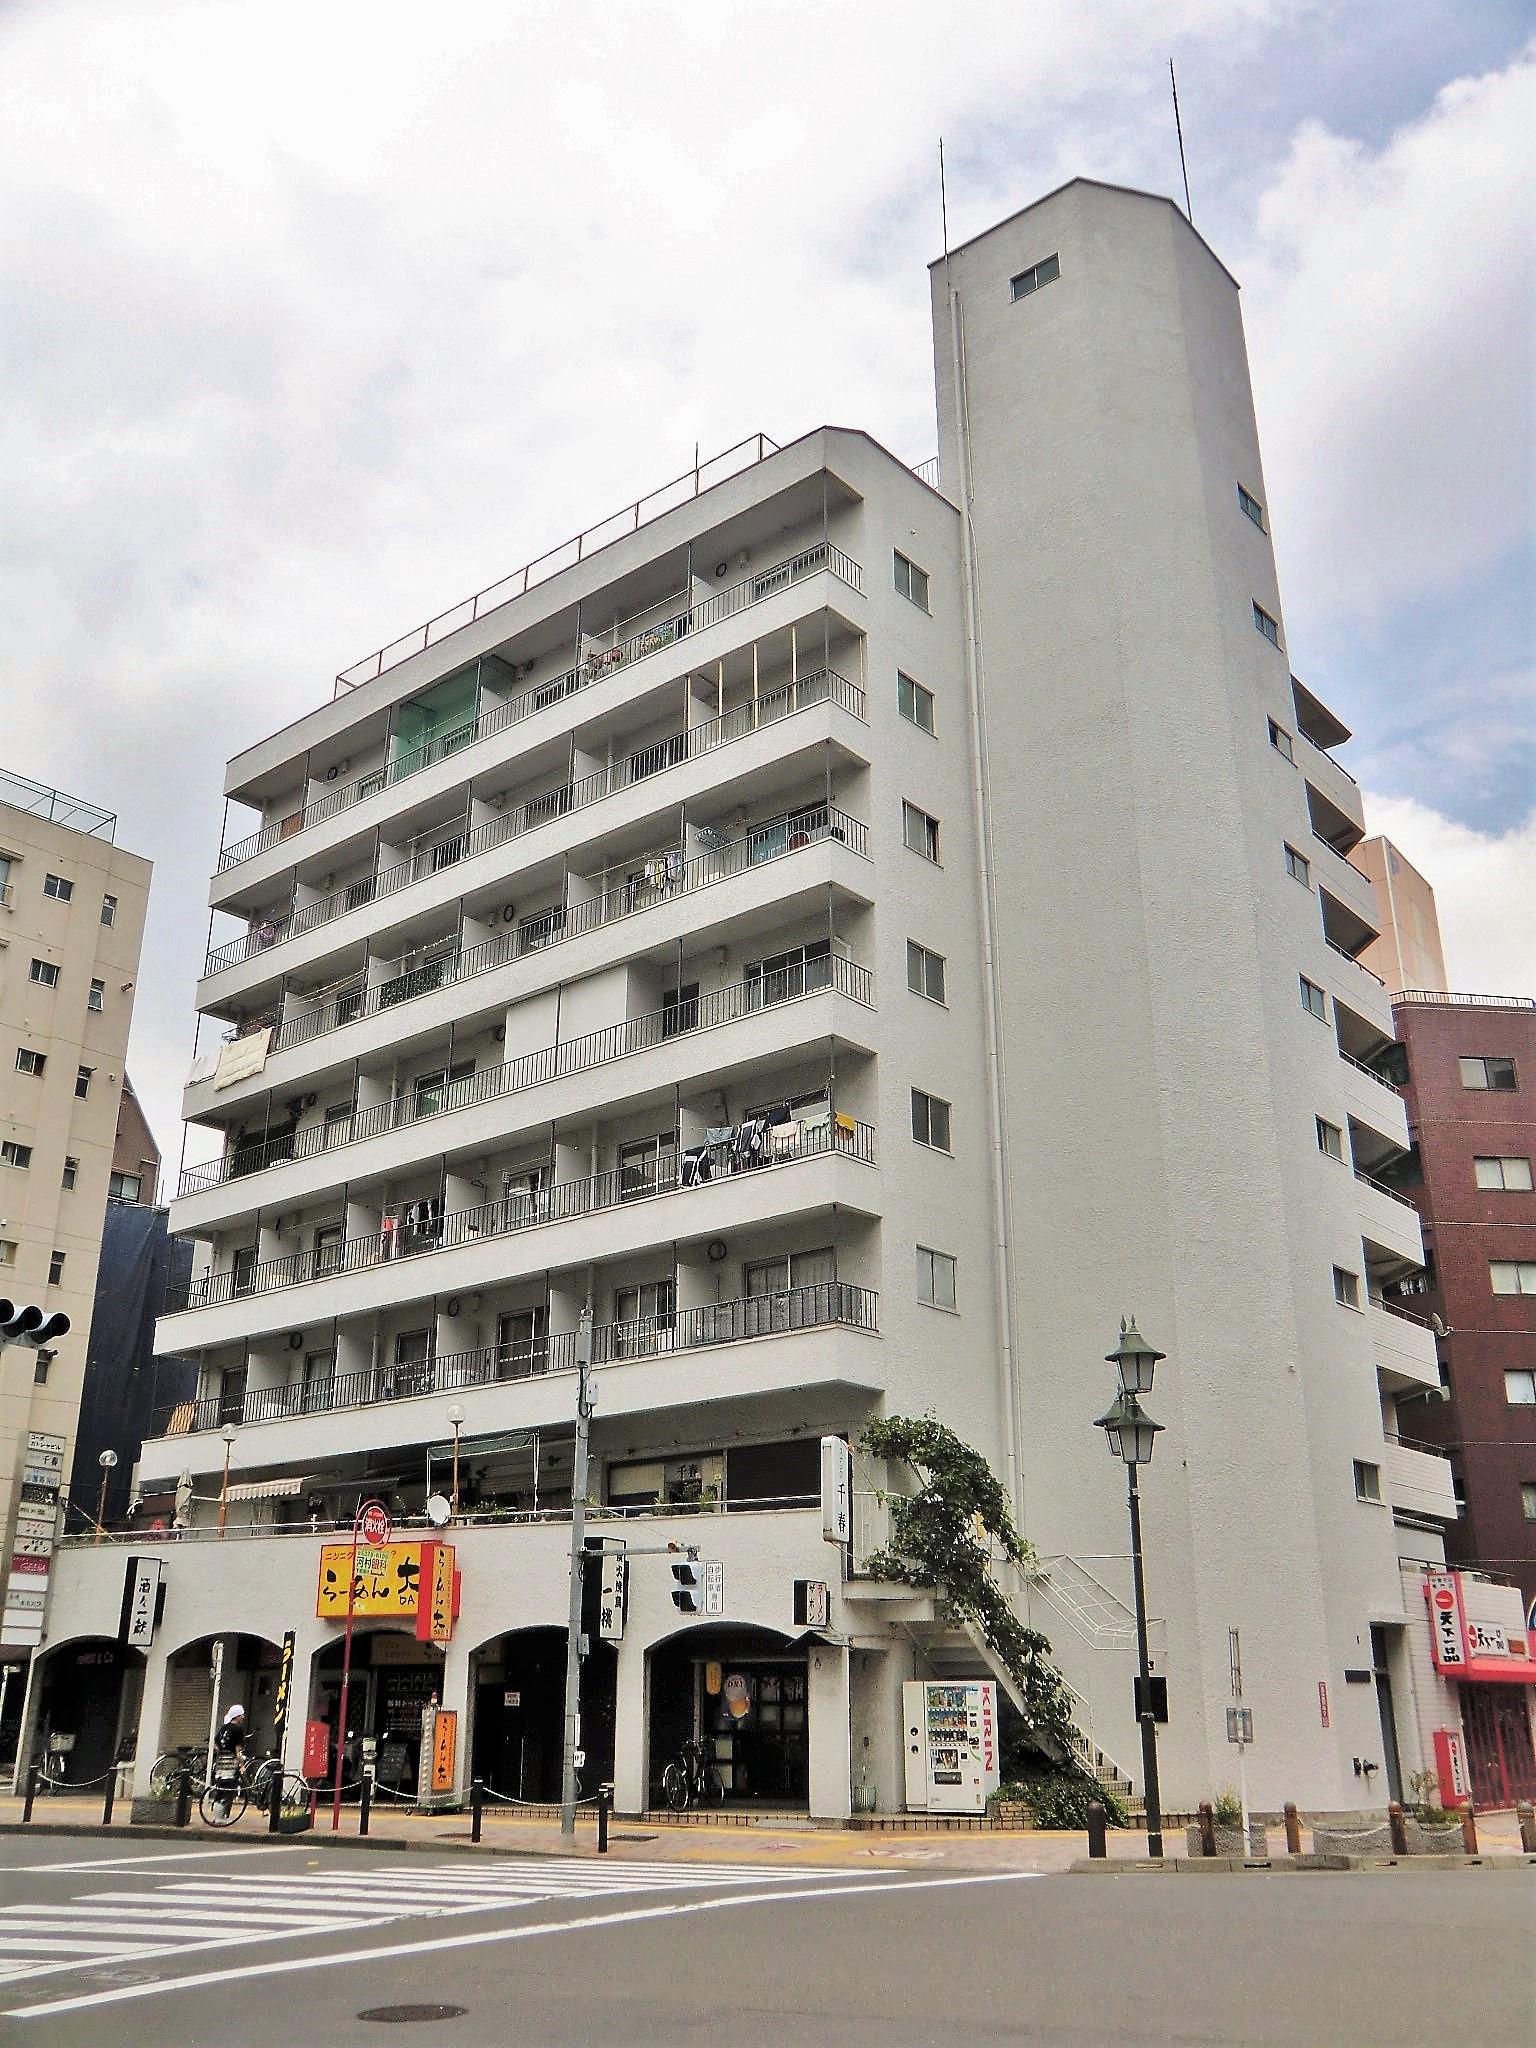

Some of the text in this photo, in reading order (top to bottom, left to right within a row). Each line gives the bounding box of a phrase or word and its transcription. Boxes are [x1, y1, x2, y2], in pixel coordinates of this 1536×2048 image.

[365, 1519, 385, 1534] 消火栓
[1440, 1611, 1460, 1662] 天下一品
[274, 1640, 292, 1725] ラーメン
